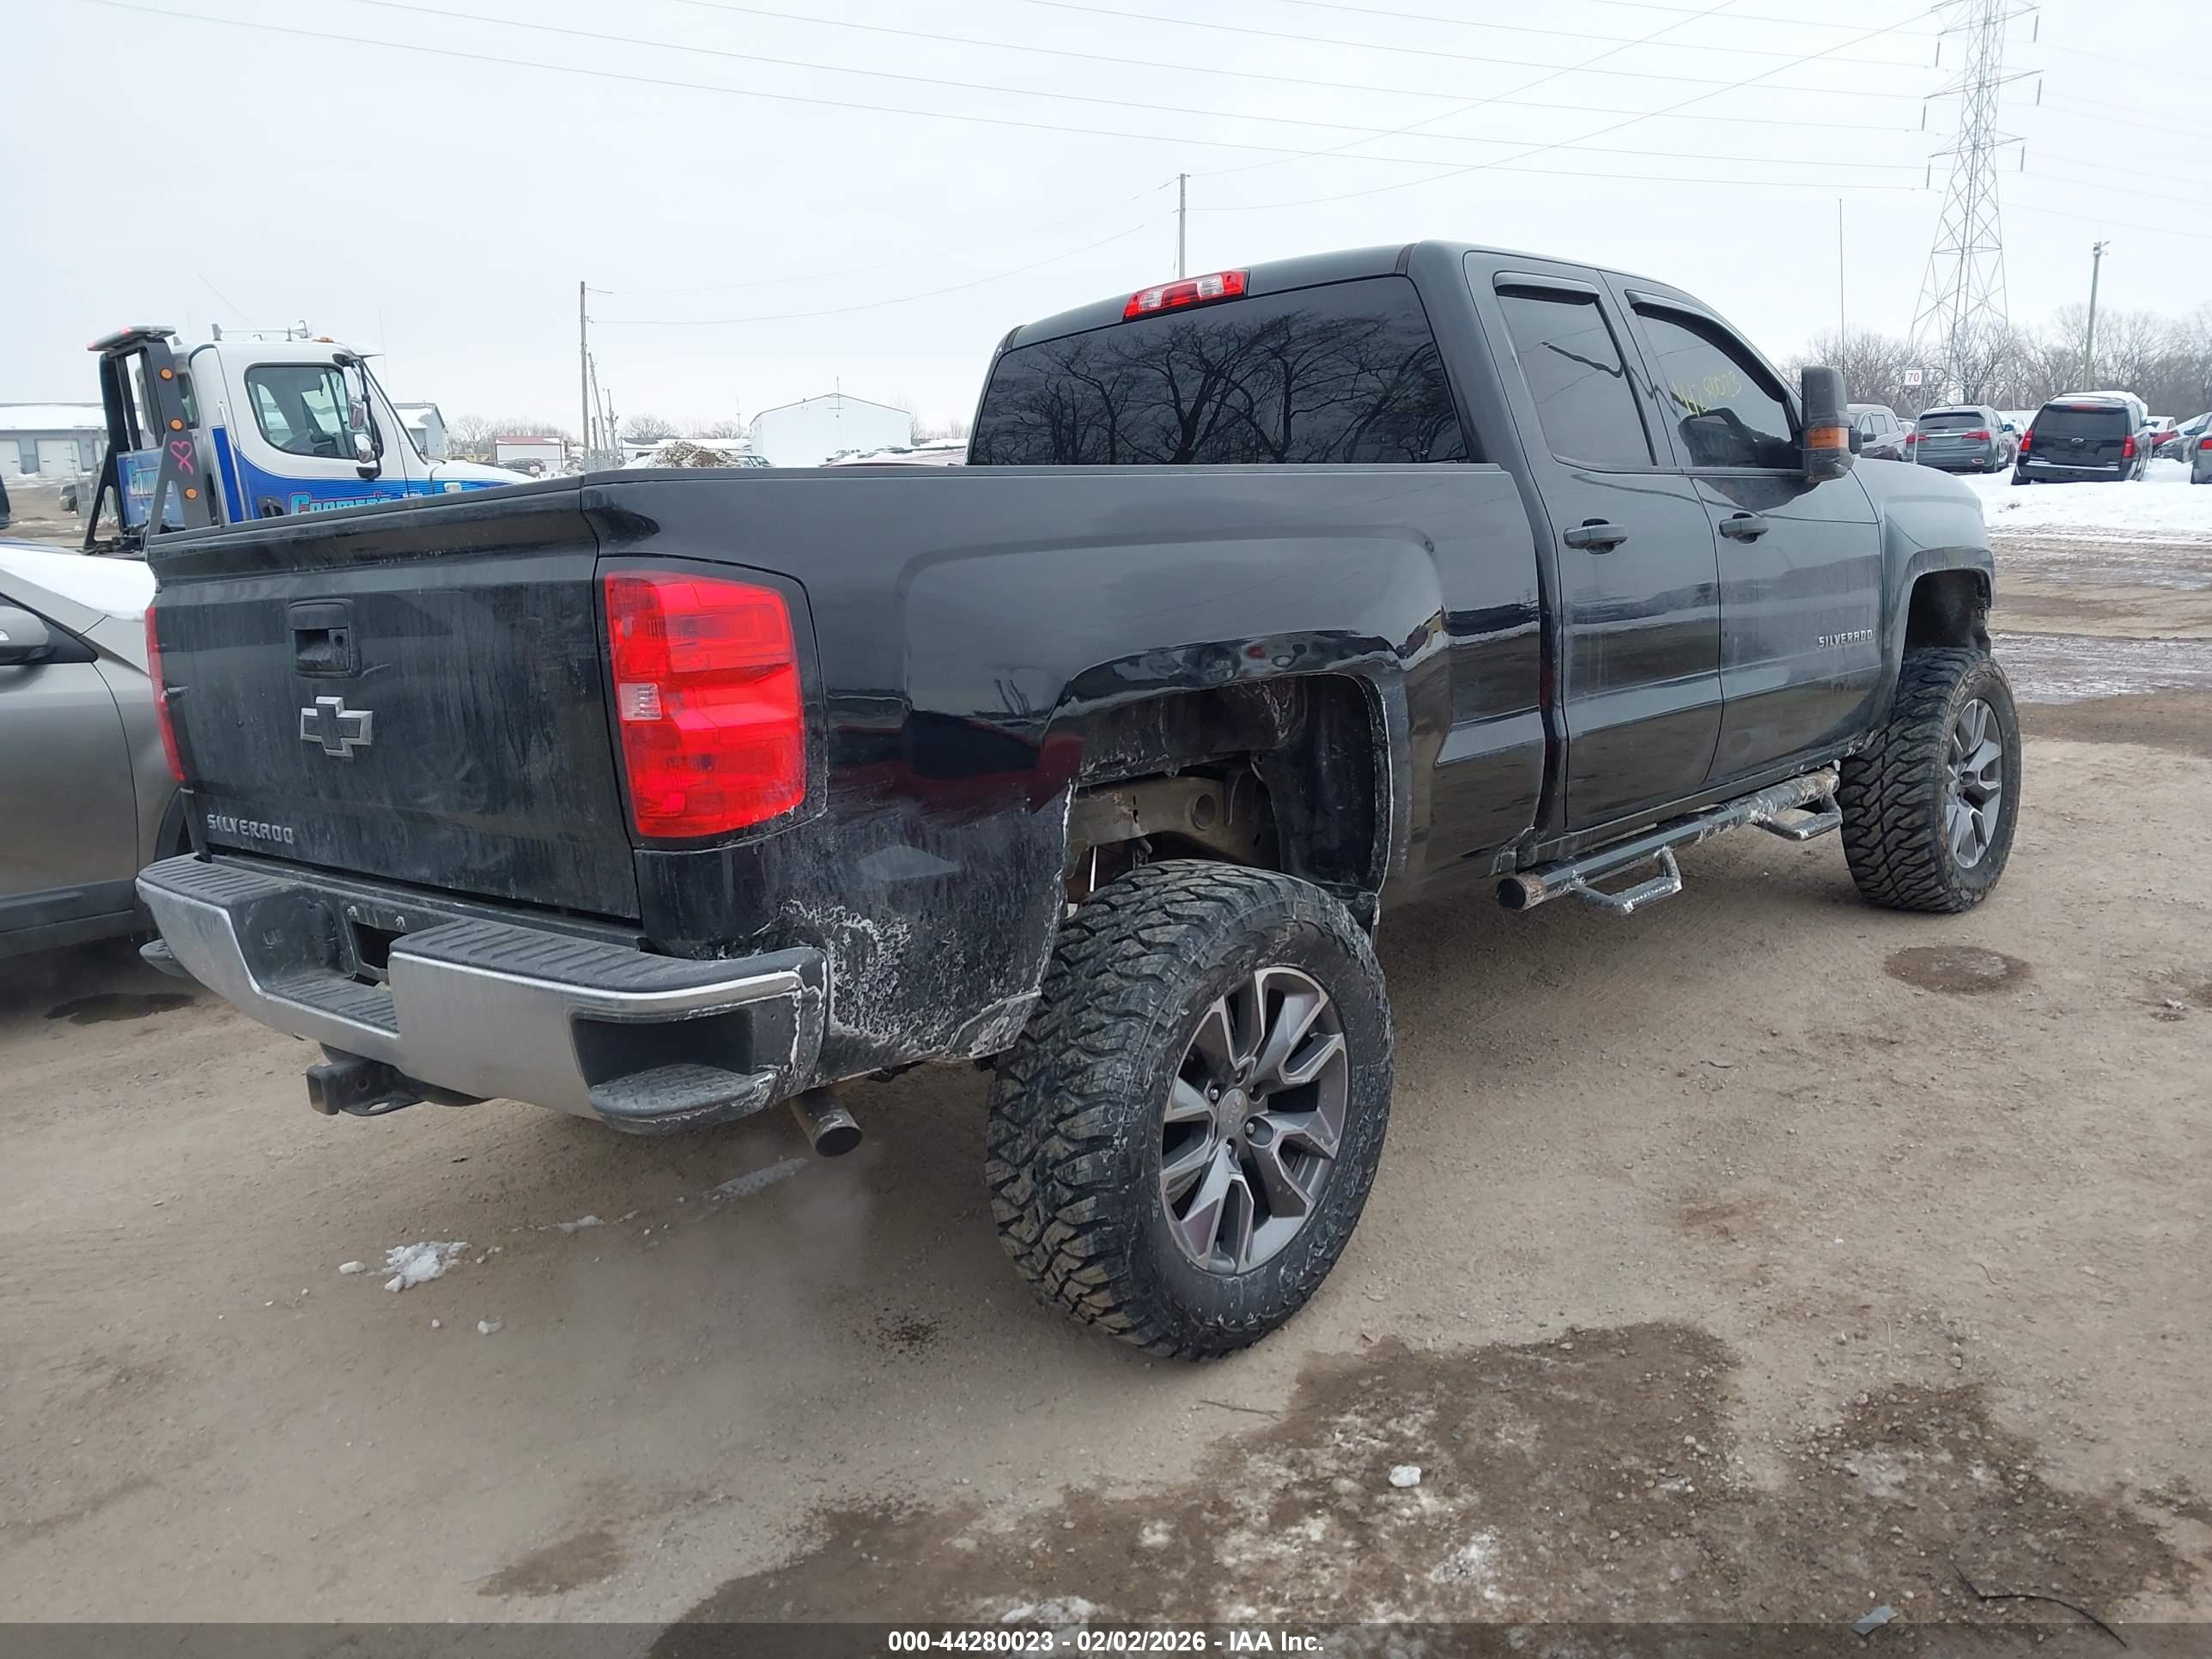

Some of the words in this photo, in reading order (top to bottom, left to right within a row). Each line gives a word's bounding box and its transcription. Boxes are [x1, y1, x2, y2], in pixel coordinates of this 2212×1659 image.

[1907, 372, 1920, 382] 70
[1818, 629, 1873, 647] SILVERADO
[206, 813, 295, 845] SILVERADO
